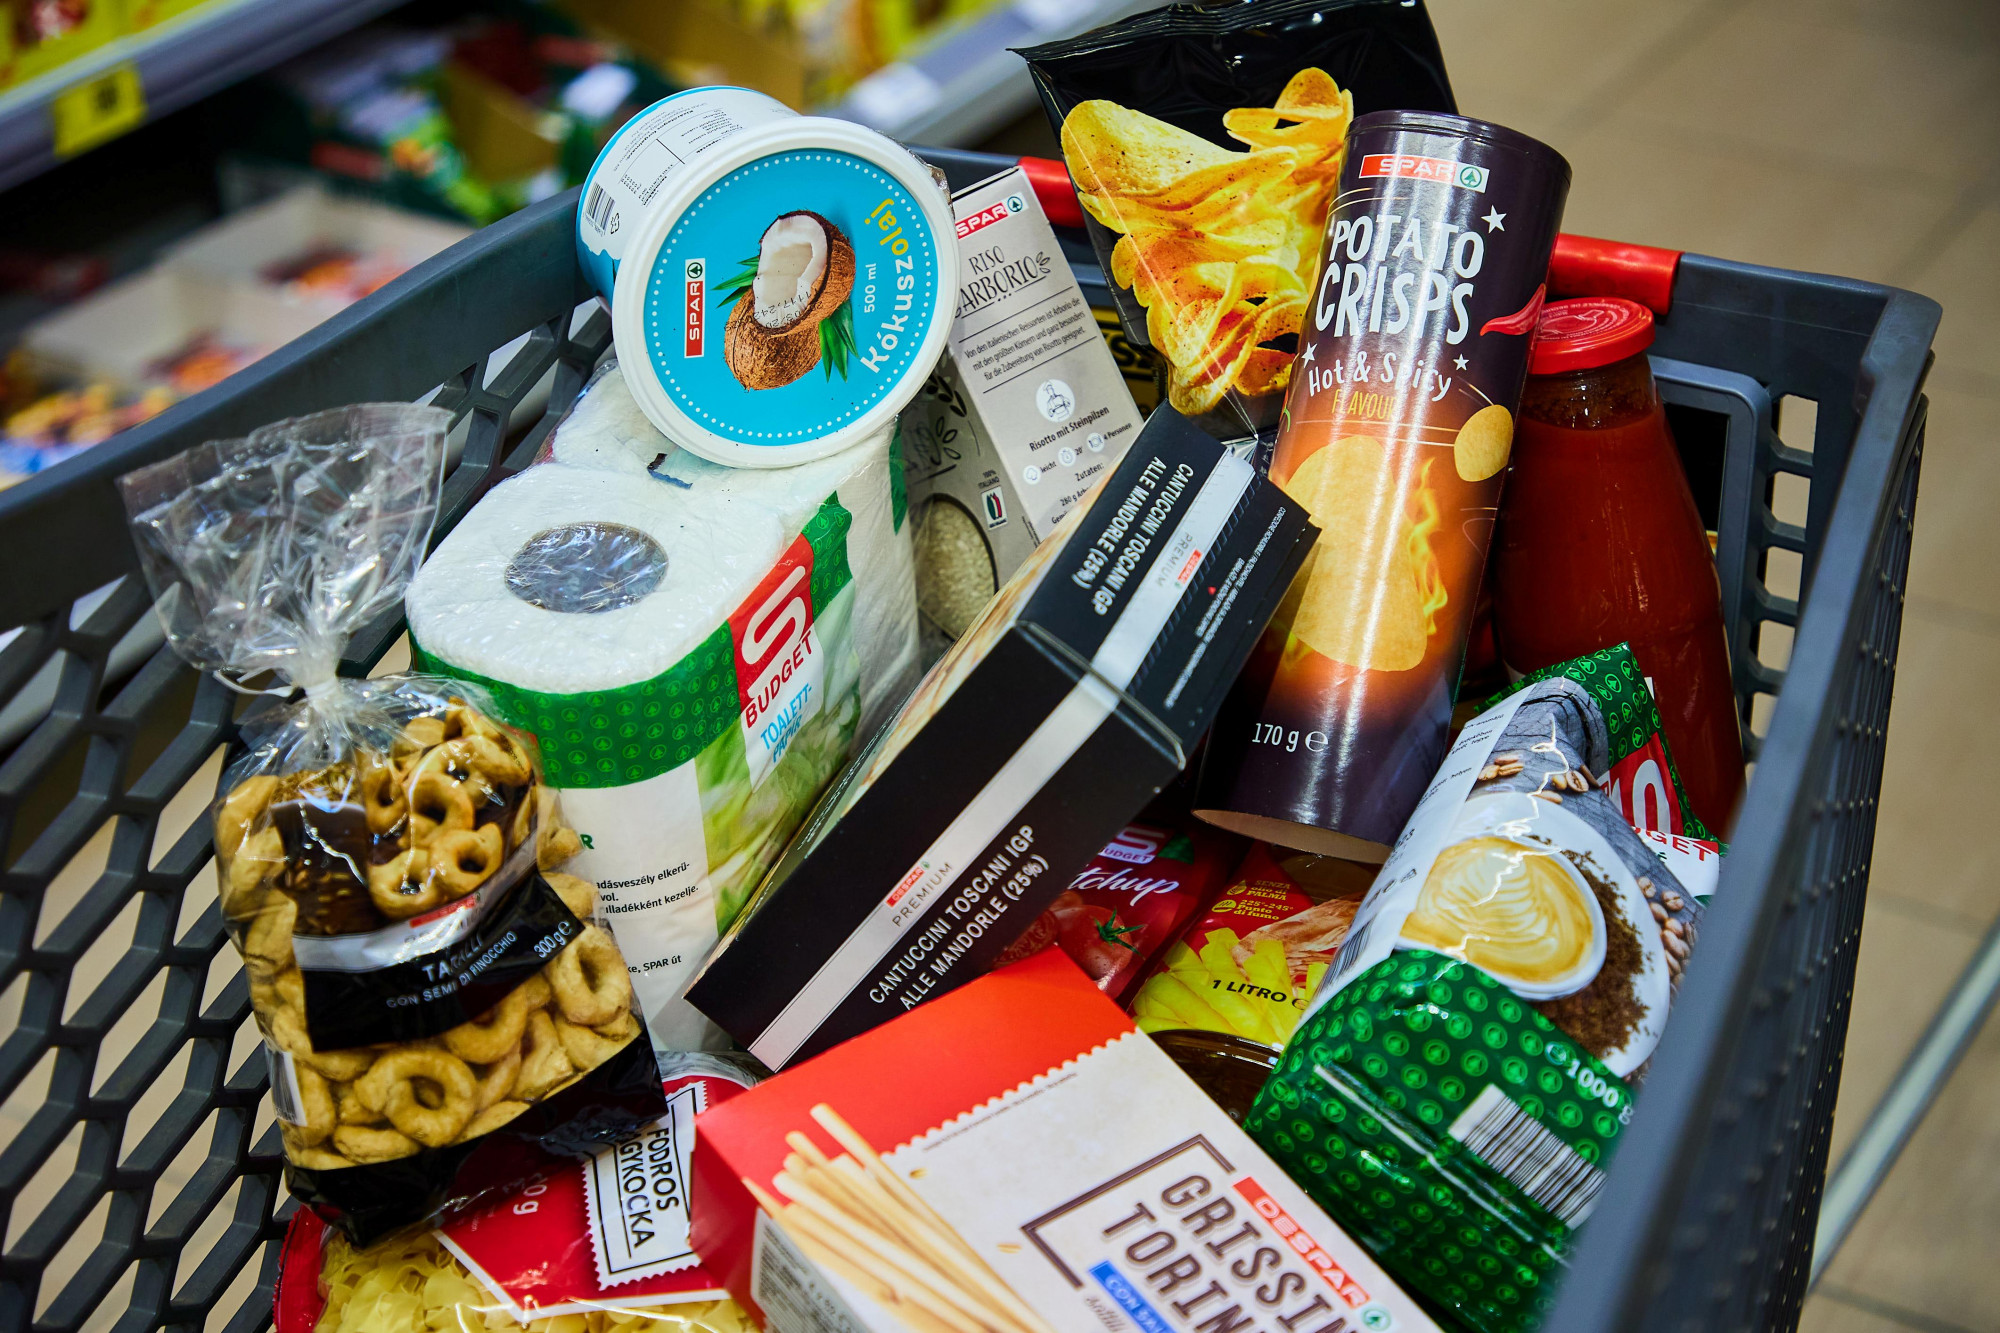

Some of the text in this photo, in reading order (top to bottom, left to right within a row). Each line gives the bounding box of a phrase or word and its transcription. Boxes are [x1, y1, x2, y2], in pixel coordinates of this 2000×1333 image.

[1379, 158, 1454, 178] SPAR
[956, 204, 1007, 236] SPAR
[968, 246, 1004, 275] RISO
[1329, 215, 1484, 279] POTATO
[860, 198, 914, 373] Kókuszolaj
[864, 263, 876, 313] 500 ml
[960, 256, 1038, 311] ARBORIO
[690, 282, 700, 341] SPAR
[1316, 262, 1474, 345] CRISPS
[972, 362, 983, 372] mit
[983, 356, 994, 366] den
[1036, 329, 1046, 340] und
[977, 344, 988, 354] den
[993, 366, 1002, 376] die
[1308, 359, 1344, 397] Hot
[1353, 350, 1371, 382] &
[1030, 406, 1109, 451] Risotto mit Steinpilzen
[1108, 422, 1132, 438] Personen
[1040, 461, 1057, 473] leicht
[1075, 462, 1104, 482] Zutaten:
[1072, 456, 1167, 590] ALLE MANDORLE (25%)
[1090, 463, 1194, 616] CANTUCCINI TOSCANI IGP
[745, 630, 812, 728] BUDGET
[760, 683, 812, 750] TOALETT-
[1252, 722, 1283, 746] 170
[1285, 730, 1300, 752] g
[1104, 848, 1150, 862] UDGET
[600, 892, 619, 902] vol.
[664, 886, 699, 904] kezelje.
[891, 867, 924, 901] DESPAR
[892, 862, 954, 928] PREMIUM
[1067, 867, 1179, 906] tchup
[1246, 890, 1286, 900] PALMA
[1255, 880, 1291, 890] SENZA
[869, 825, 1034, 1004] CANTUCCINI TOSCANI IGP
[1237, 905, 1272, 914] Punto
[1247, 911, 1280, 920] fumo
[534, 934, 557, 958] 300
[553, 930, 566, 946] g
[900, 854, 1049, 1010] ALLE MANDORLE (25%)
[386, 930, 518, 1009] CON SEMI DI FINOCCHIO
[643, 958, 669, 972] SPAR
[671, 954, 682, 965] út
[1213, 980, 1287, 1002] 1 LITRO
[1566, 1059, 1619, 1108] 1000
[647, 1128, 679, 1211] FODROS
[513, 1200, 538, 1216] g
[1255, 1199, 1366, 1306] DESPAR
[1107, 1276, 1172, 1333] CON SAL
